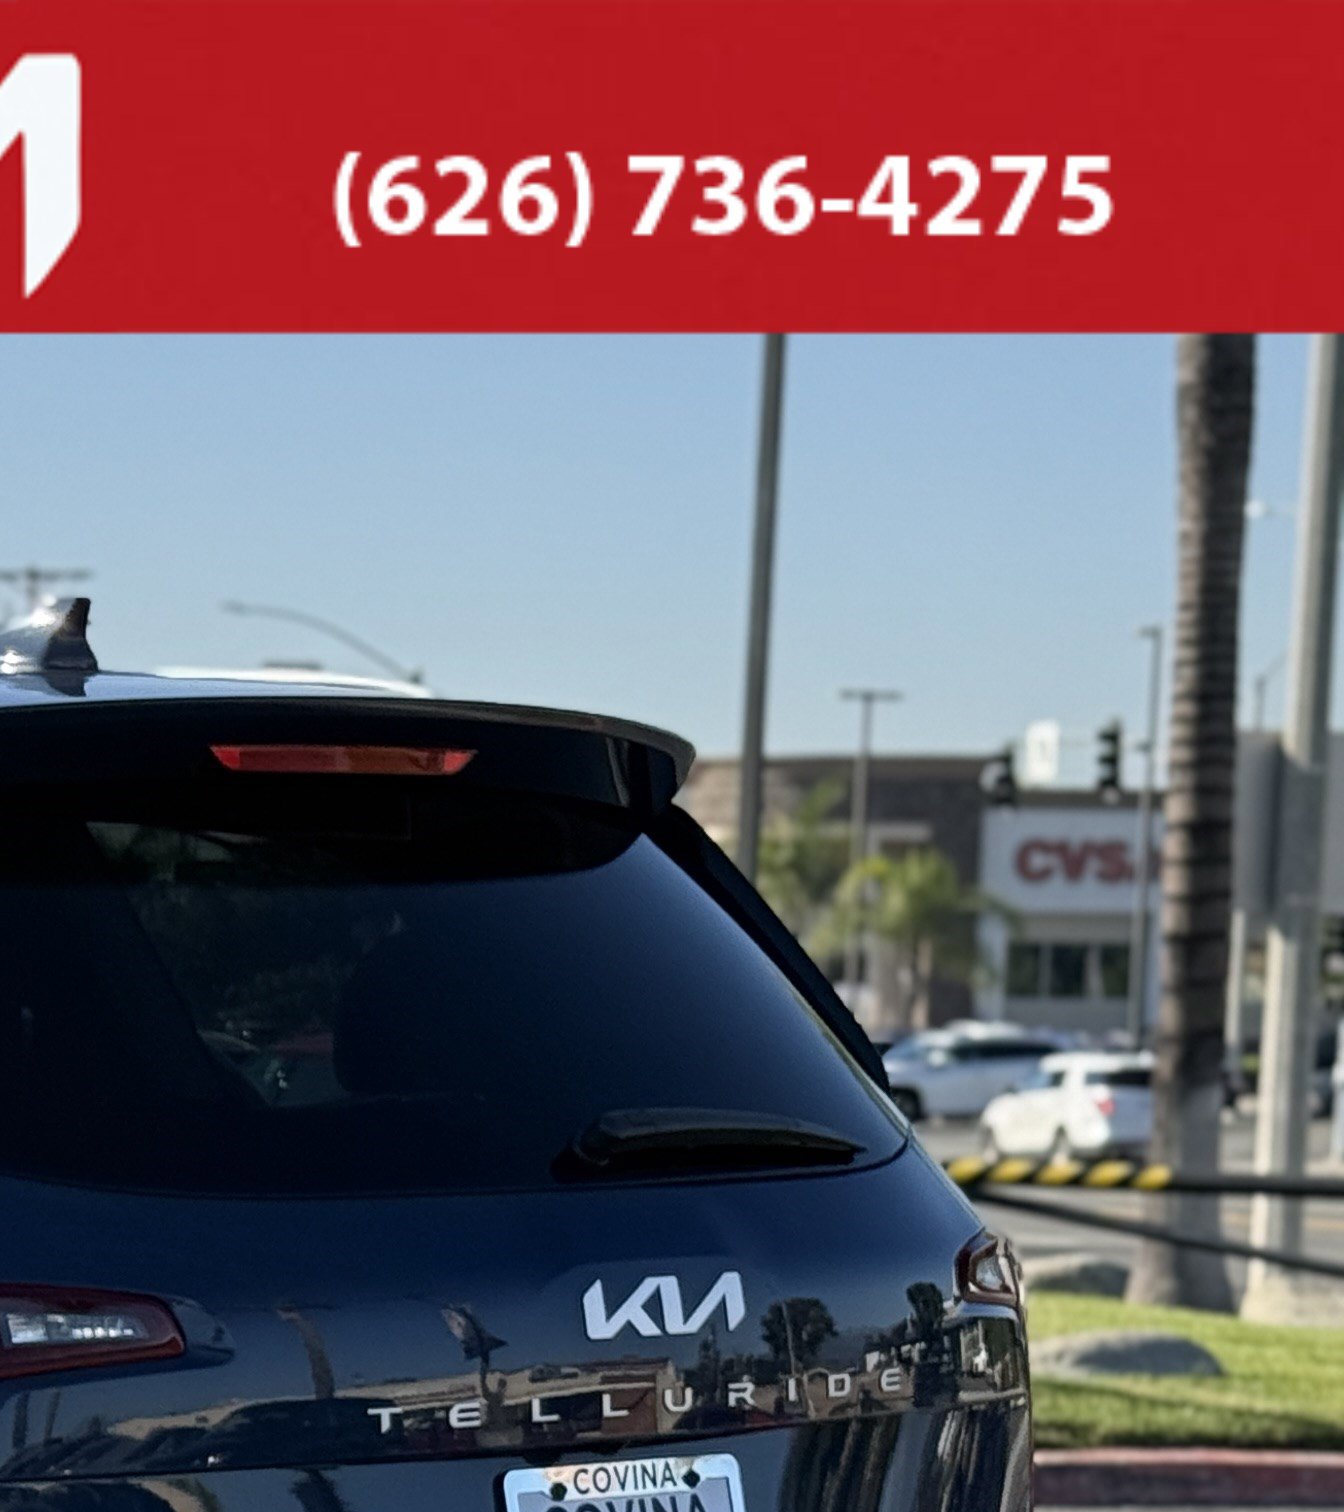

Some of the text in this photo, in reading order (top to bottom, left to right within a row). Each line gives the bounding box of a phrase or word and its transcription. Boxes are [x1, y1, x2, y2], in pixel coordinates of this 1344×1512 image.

[582, 1271, 746, 1340] KIA
[367, 1367, 903, 1434] TELLURIDE
[573, 1461, 677, 1495] COVINA
